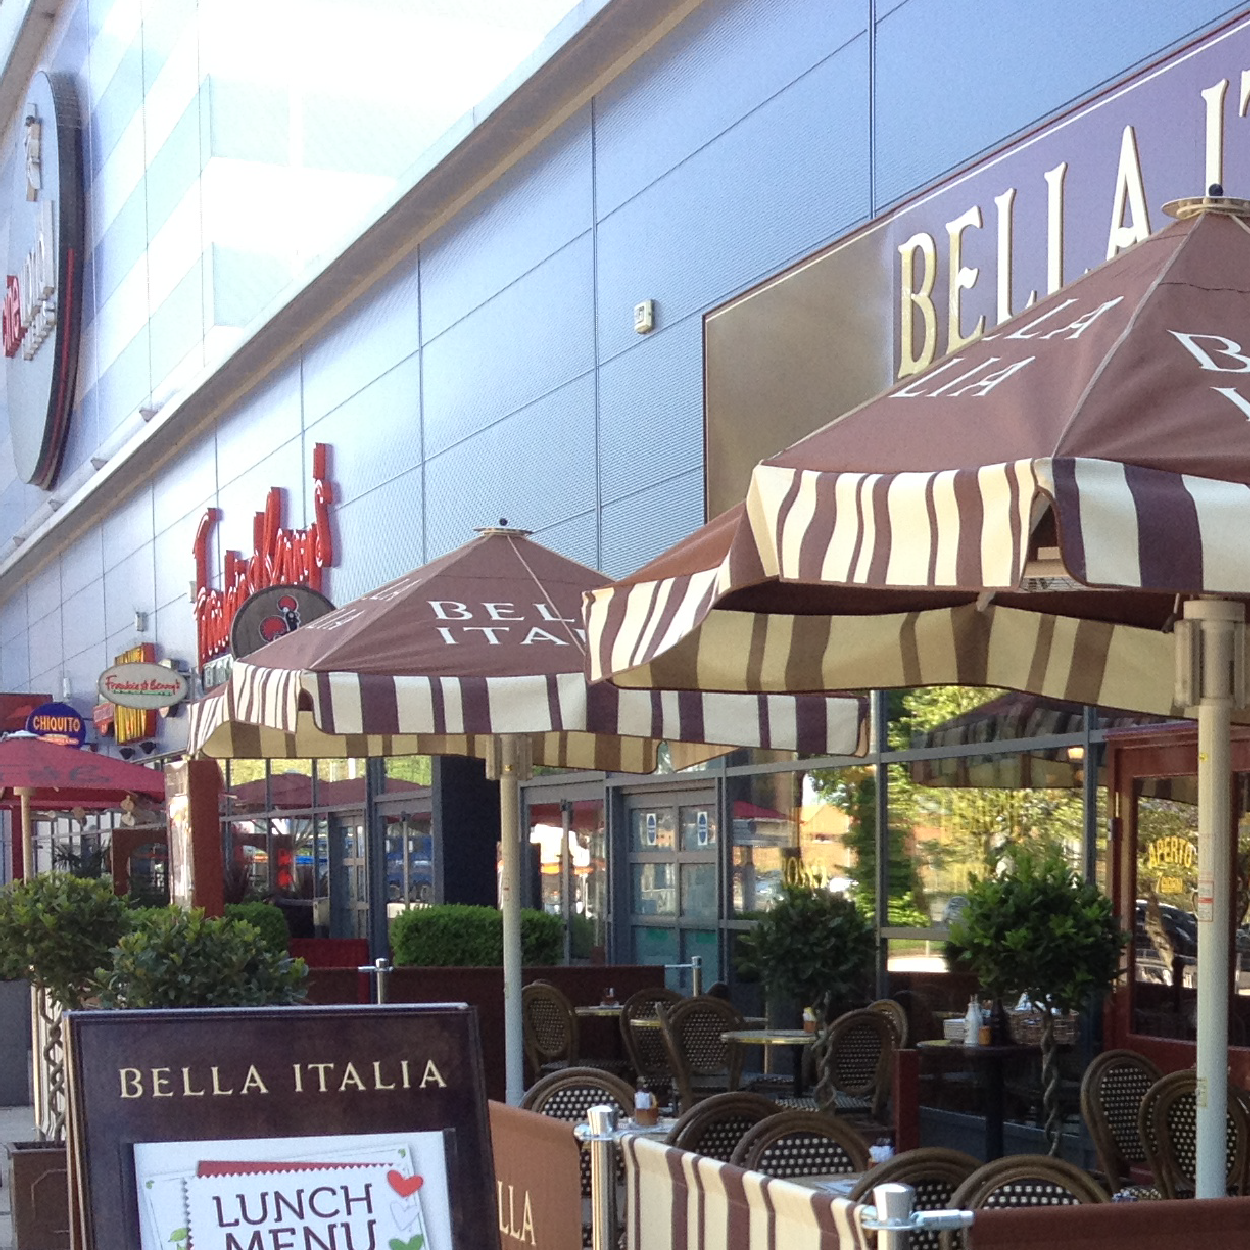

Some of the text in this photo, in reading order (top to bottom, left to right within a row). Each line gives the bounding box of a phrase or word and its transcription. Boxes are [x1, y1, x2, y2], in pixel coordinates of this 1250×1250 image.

[897, 125, 1151, 379] BELLA
[427, 600, 576, 622] BEL
[32, 715, 81, 733] CHIQUITO
[1148, 835, 1193, 869] APERTO
[118, 1059, 447, 1098] BELLA ITALIA
[212, 1183, 373, 1228] LUNCH
